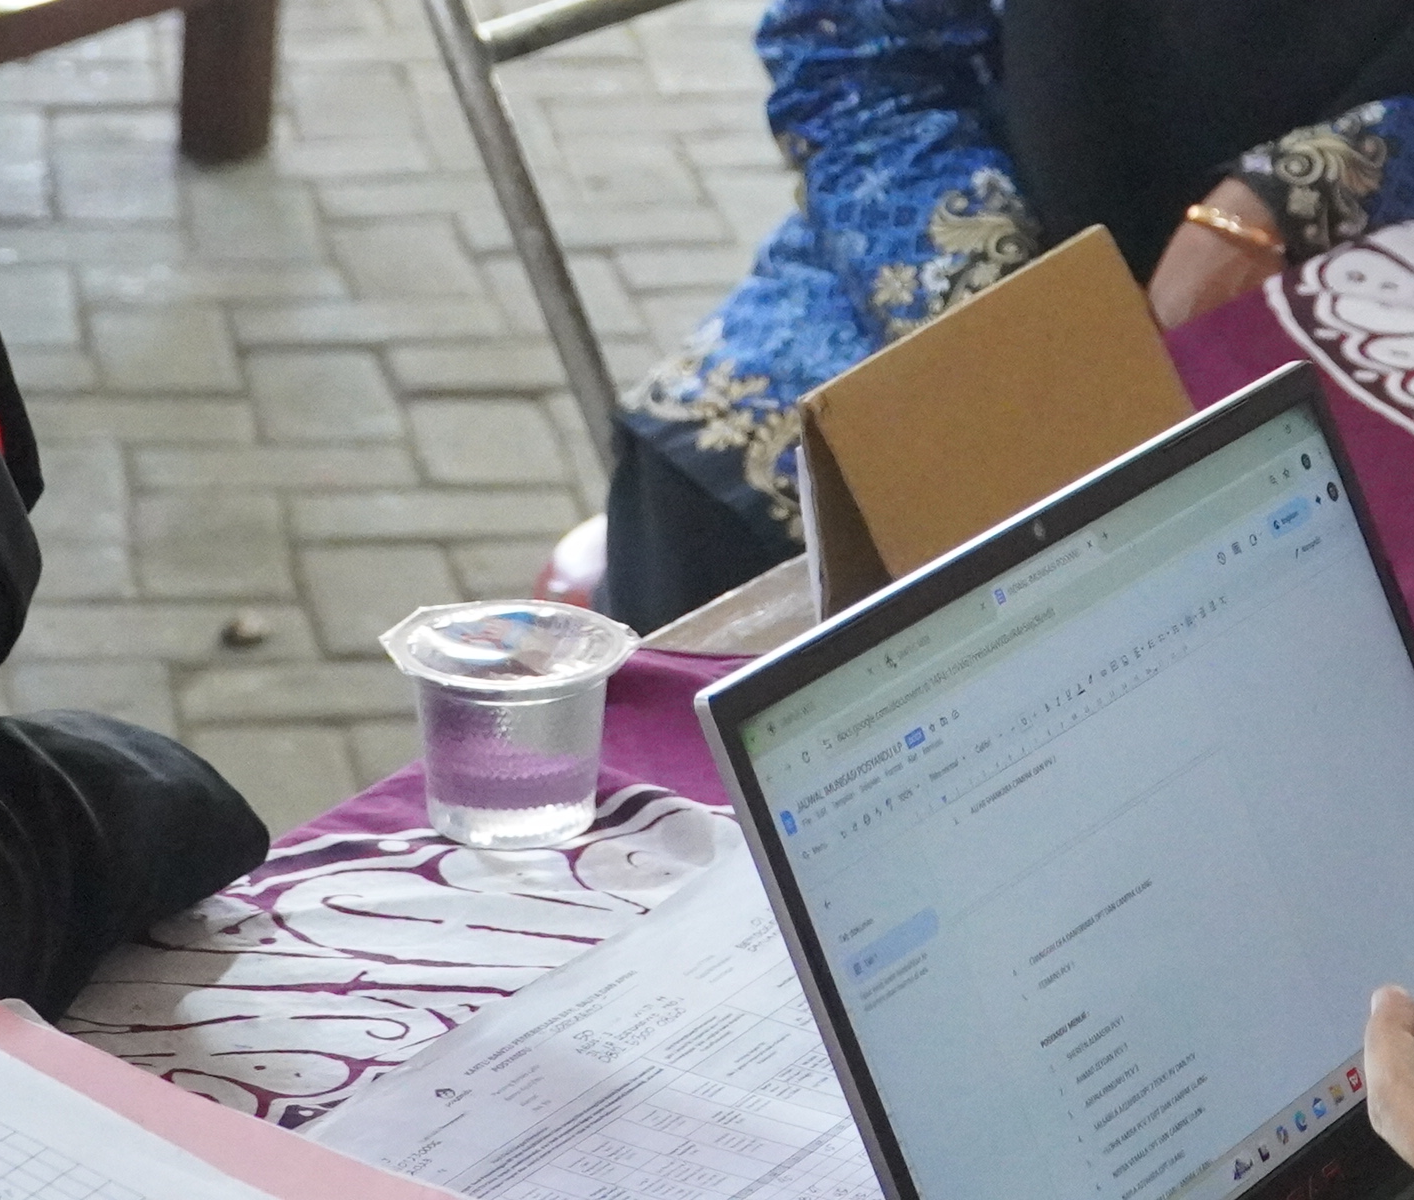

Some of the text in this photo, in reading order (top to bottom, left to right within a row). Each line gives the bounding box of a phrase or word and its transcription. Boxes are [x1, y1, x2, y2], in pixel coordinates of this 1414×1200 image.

[798, 792, 823, 813] JADWAL
[824, 770, 857, 795] IMUNISASI
[857, 749, 893, 774] POSYANDU
[492, 1049, 530, 1072] POSYANDU
